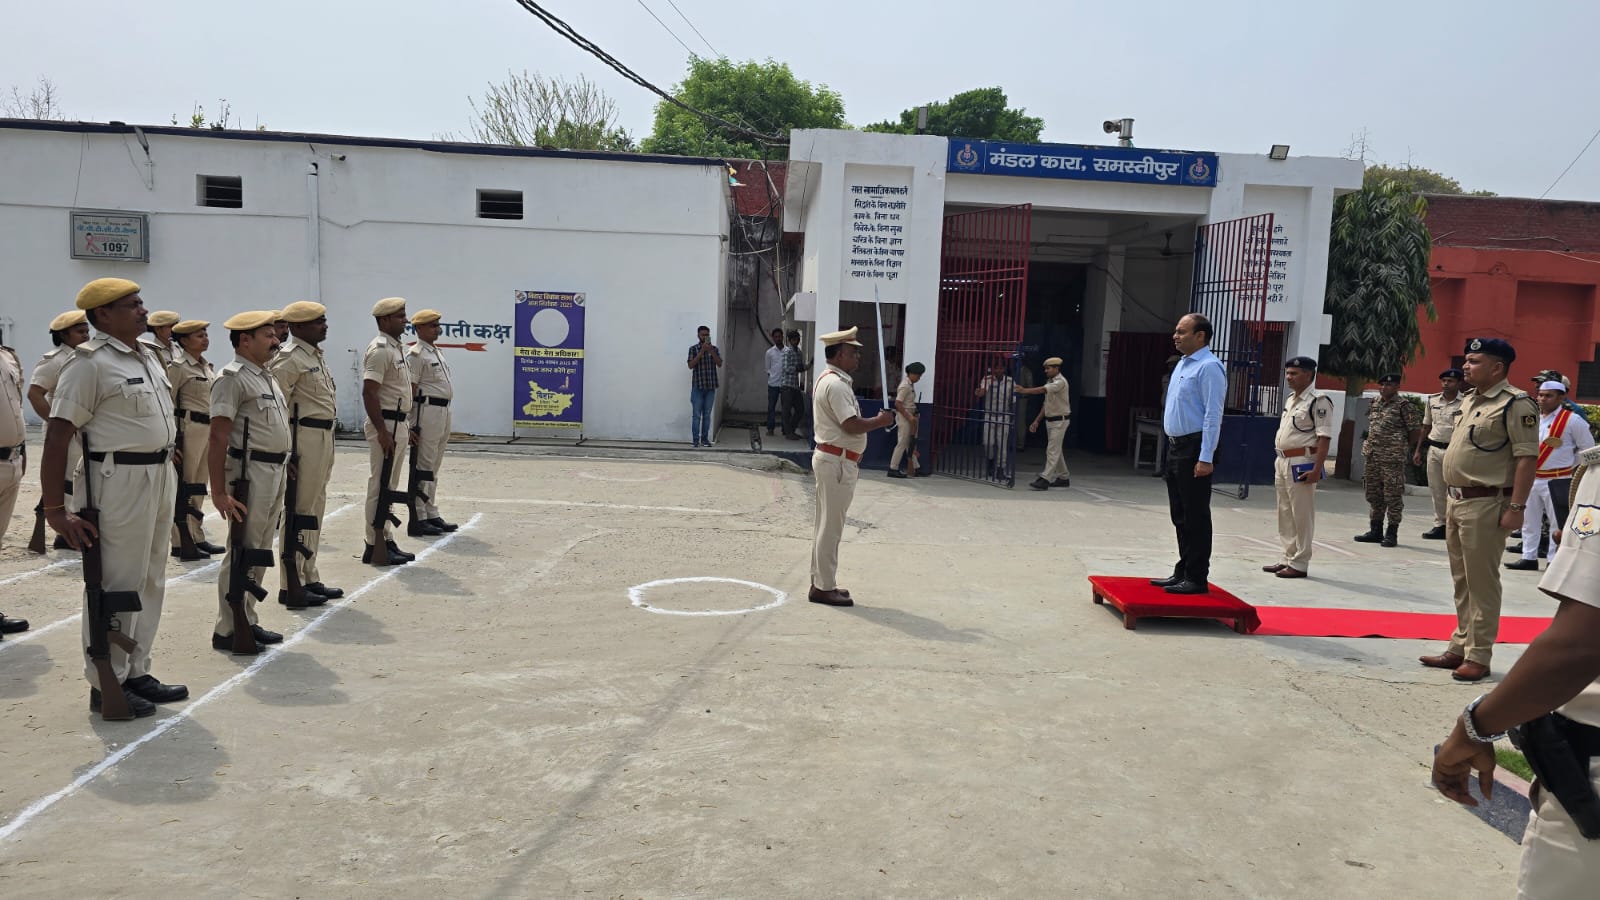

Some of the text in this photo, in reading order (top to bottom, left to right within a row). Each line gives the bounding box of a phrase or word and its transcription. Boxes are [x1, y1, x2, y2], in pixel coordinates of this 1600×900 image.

[990, 147, 1180, 181] मंडल कारा, समस्तीपुर
[102, 242, 129, 252] 1097
[473, 324, 512, 344] कक्ष
